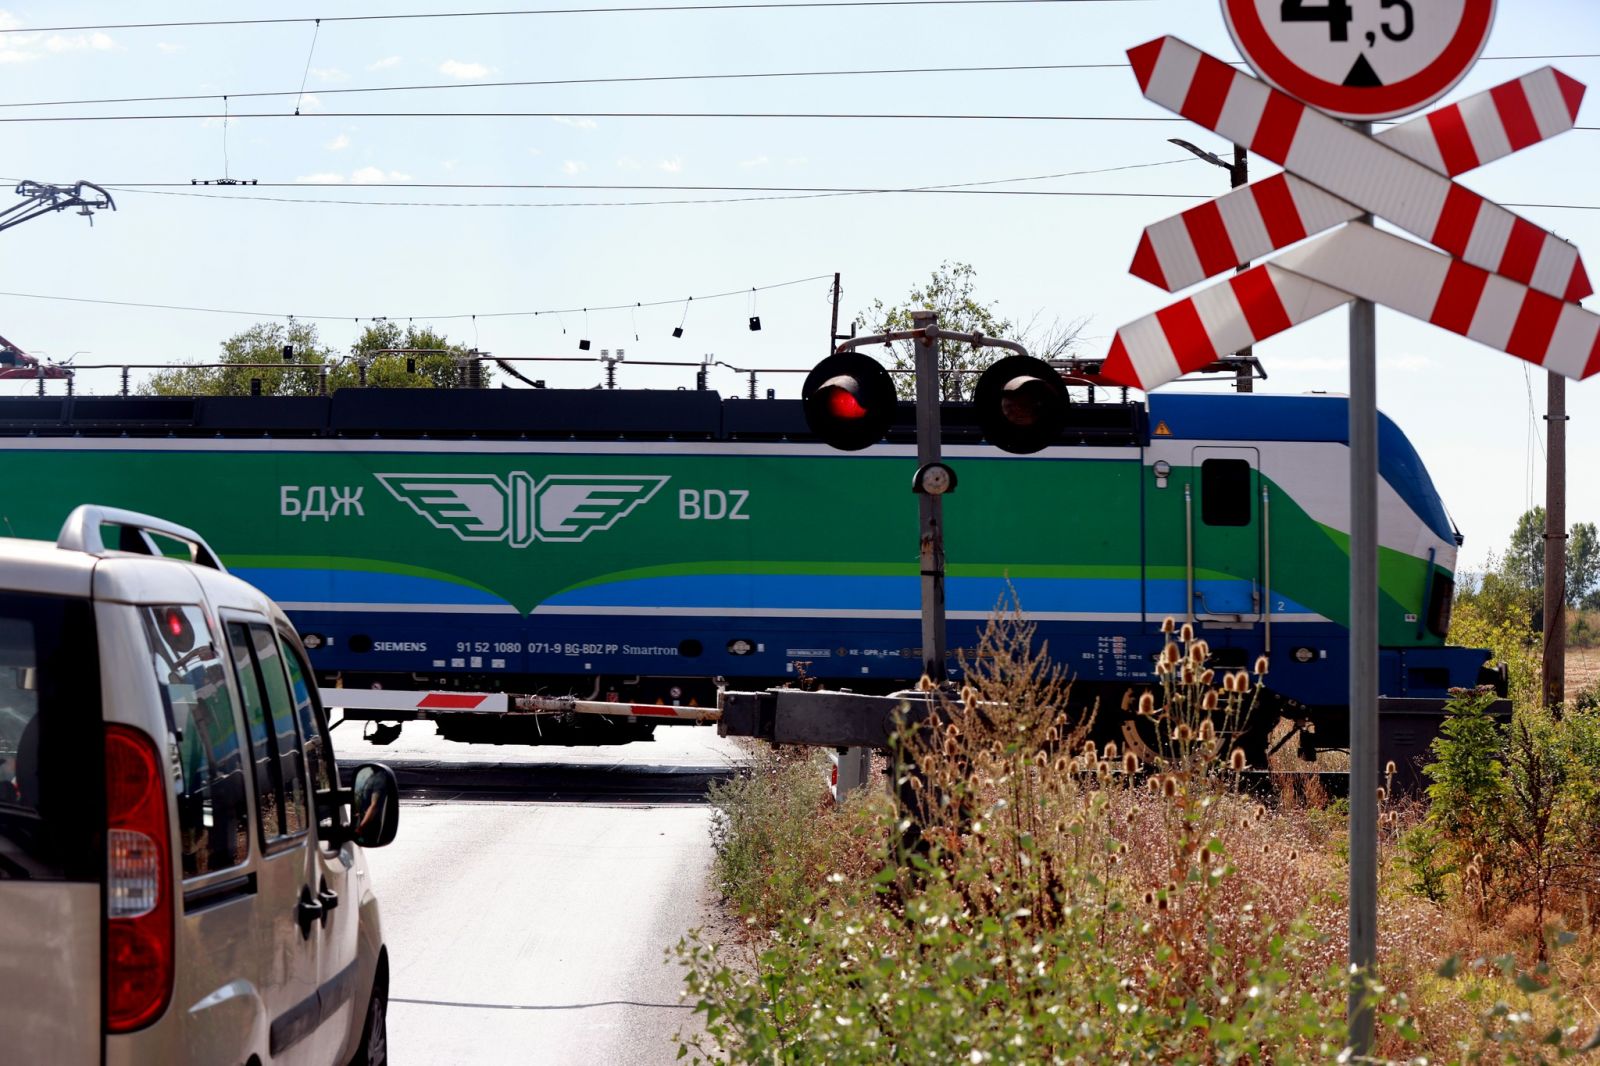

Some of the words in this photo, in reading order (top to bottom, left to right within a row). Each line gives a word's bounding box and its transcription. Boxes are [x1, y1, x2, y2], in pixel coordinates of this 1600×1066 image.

[280, 485, 365, 522] БДЖ
[679, 489, 750, 520] BDZ
[1277, 601, 1285, 611] 2
[373, 641, 427, 652] SIEMENS
[456, 642, 471, 652] 91
[474, 642, 489, 653] 52
[493, 642, 521, 653] 1080
[528, 643, 561, 653] 071-9
[564, 643, 603, 656] BG-BDZ
[605, 644, 618, 654] PP
[622, 644, 678, 655] Smartron
